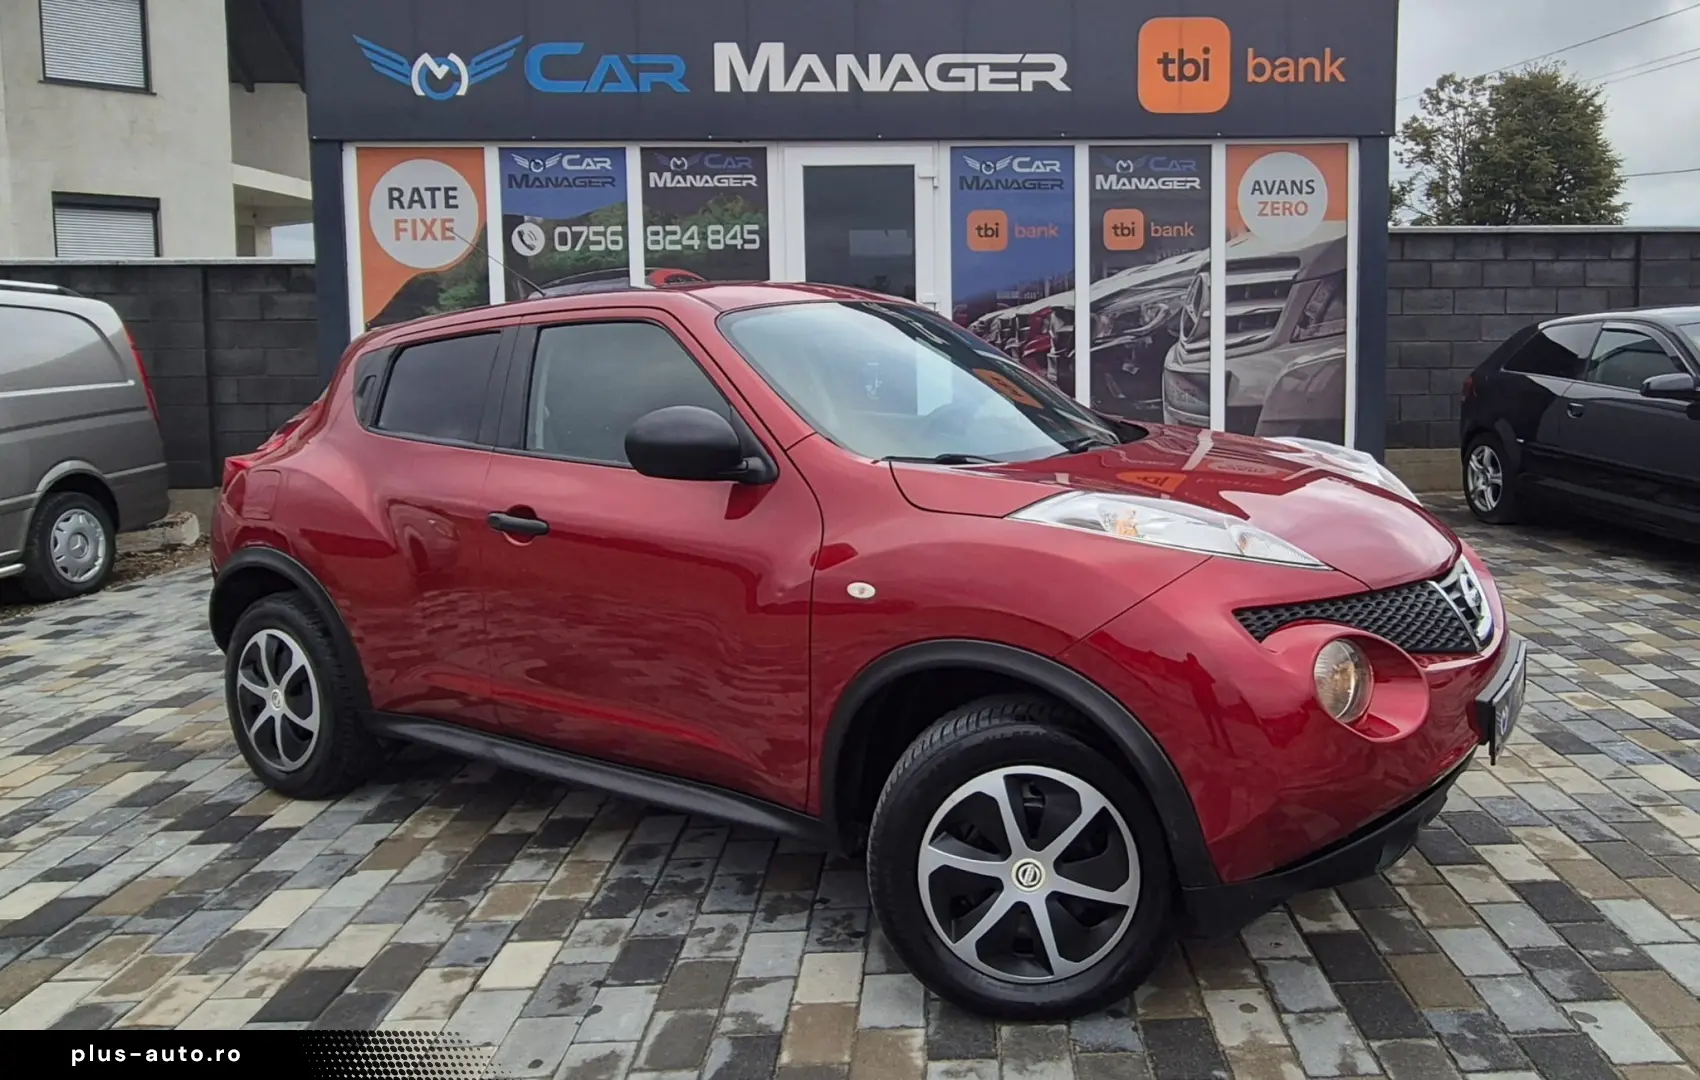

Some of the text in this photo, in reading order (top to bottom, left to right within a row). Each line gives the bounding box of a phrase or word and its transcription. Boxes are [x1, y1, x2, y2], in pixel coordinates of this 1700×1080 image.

[524, 42, 1072, 93] CAR MANAGER
[1156, 46, 1346, 83] tbi bank
[561, 154, 613, 171] CAR
[703, 153, 753, 169] CAR
[1012, 156, 1062, 173] CAR
[1149, 156, 1198, 172] CAR
[508, 174, 616, 189] MANAGER
[649, 172, 758, 188] MANAGER
[959, 176, 1065, 191] MANAGER
[1095, 174, 1202, 190] MANAGER
[1250, 179, 1316, 196] AVANS
[387, 186, 459, 210] RATE
[1257, 200, 1309, 217] ZERO
[394, 217, 456, 242] FIXE
[554, 224, 760, 251] 0756 824 845
[975, 222, 1059, 239] tbi bank
[1111, 222, 1194, 238] tbi bank
